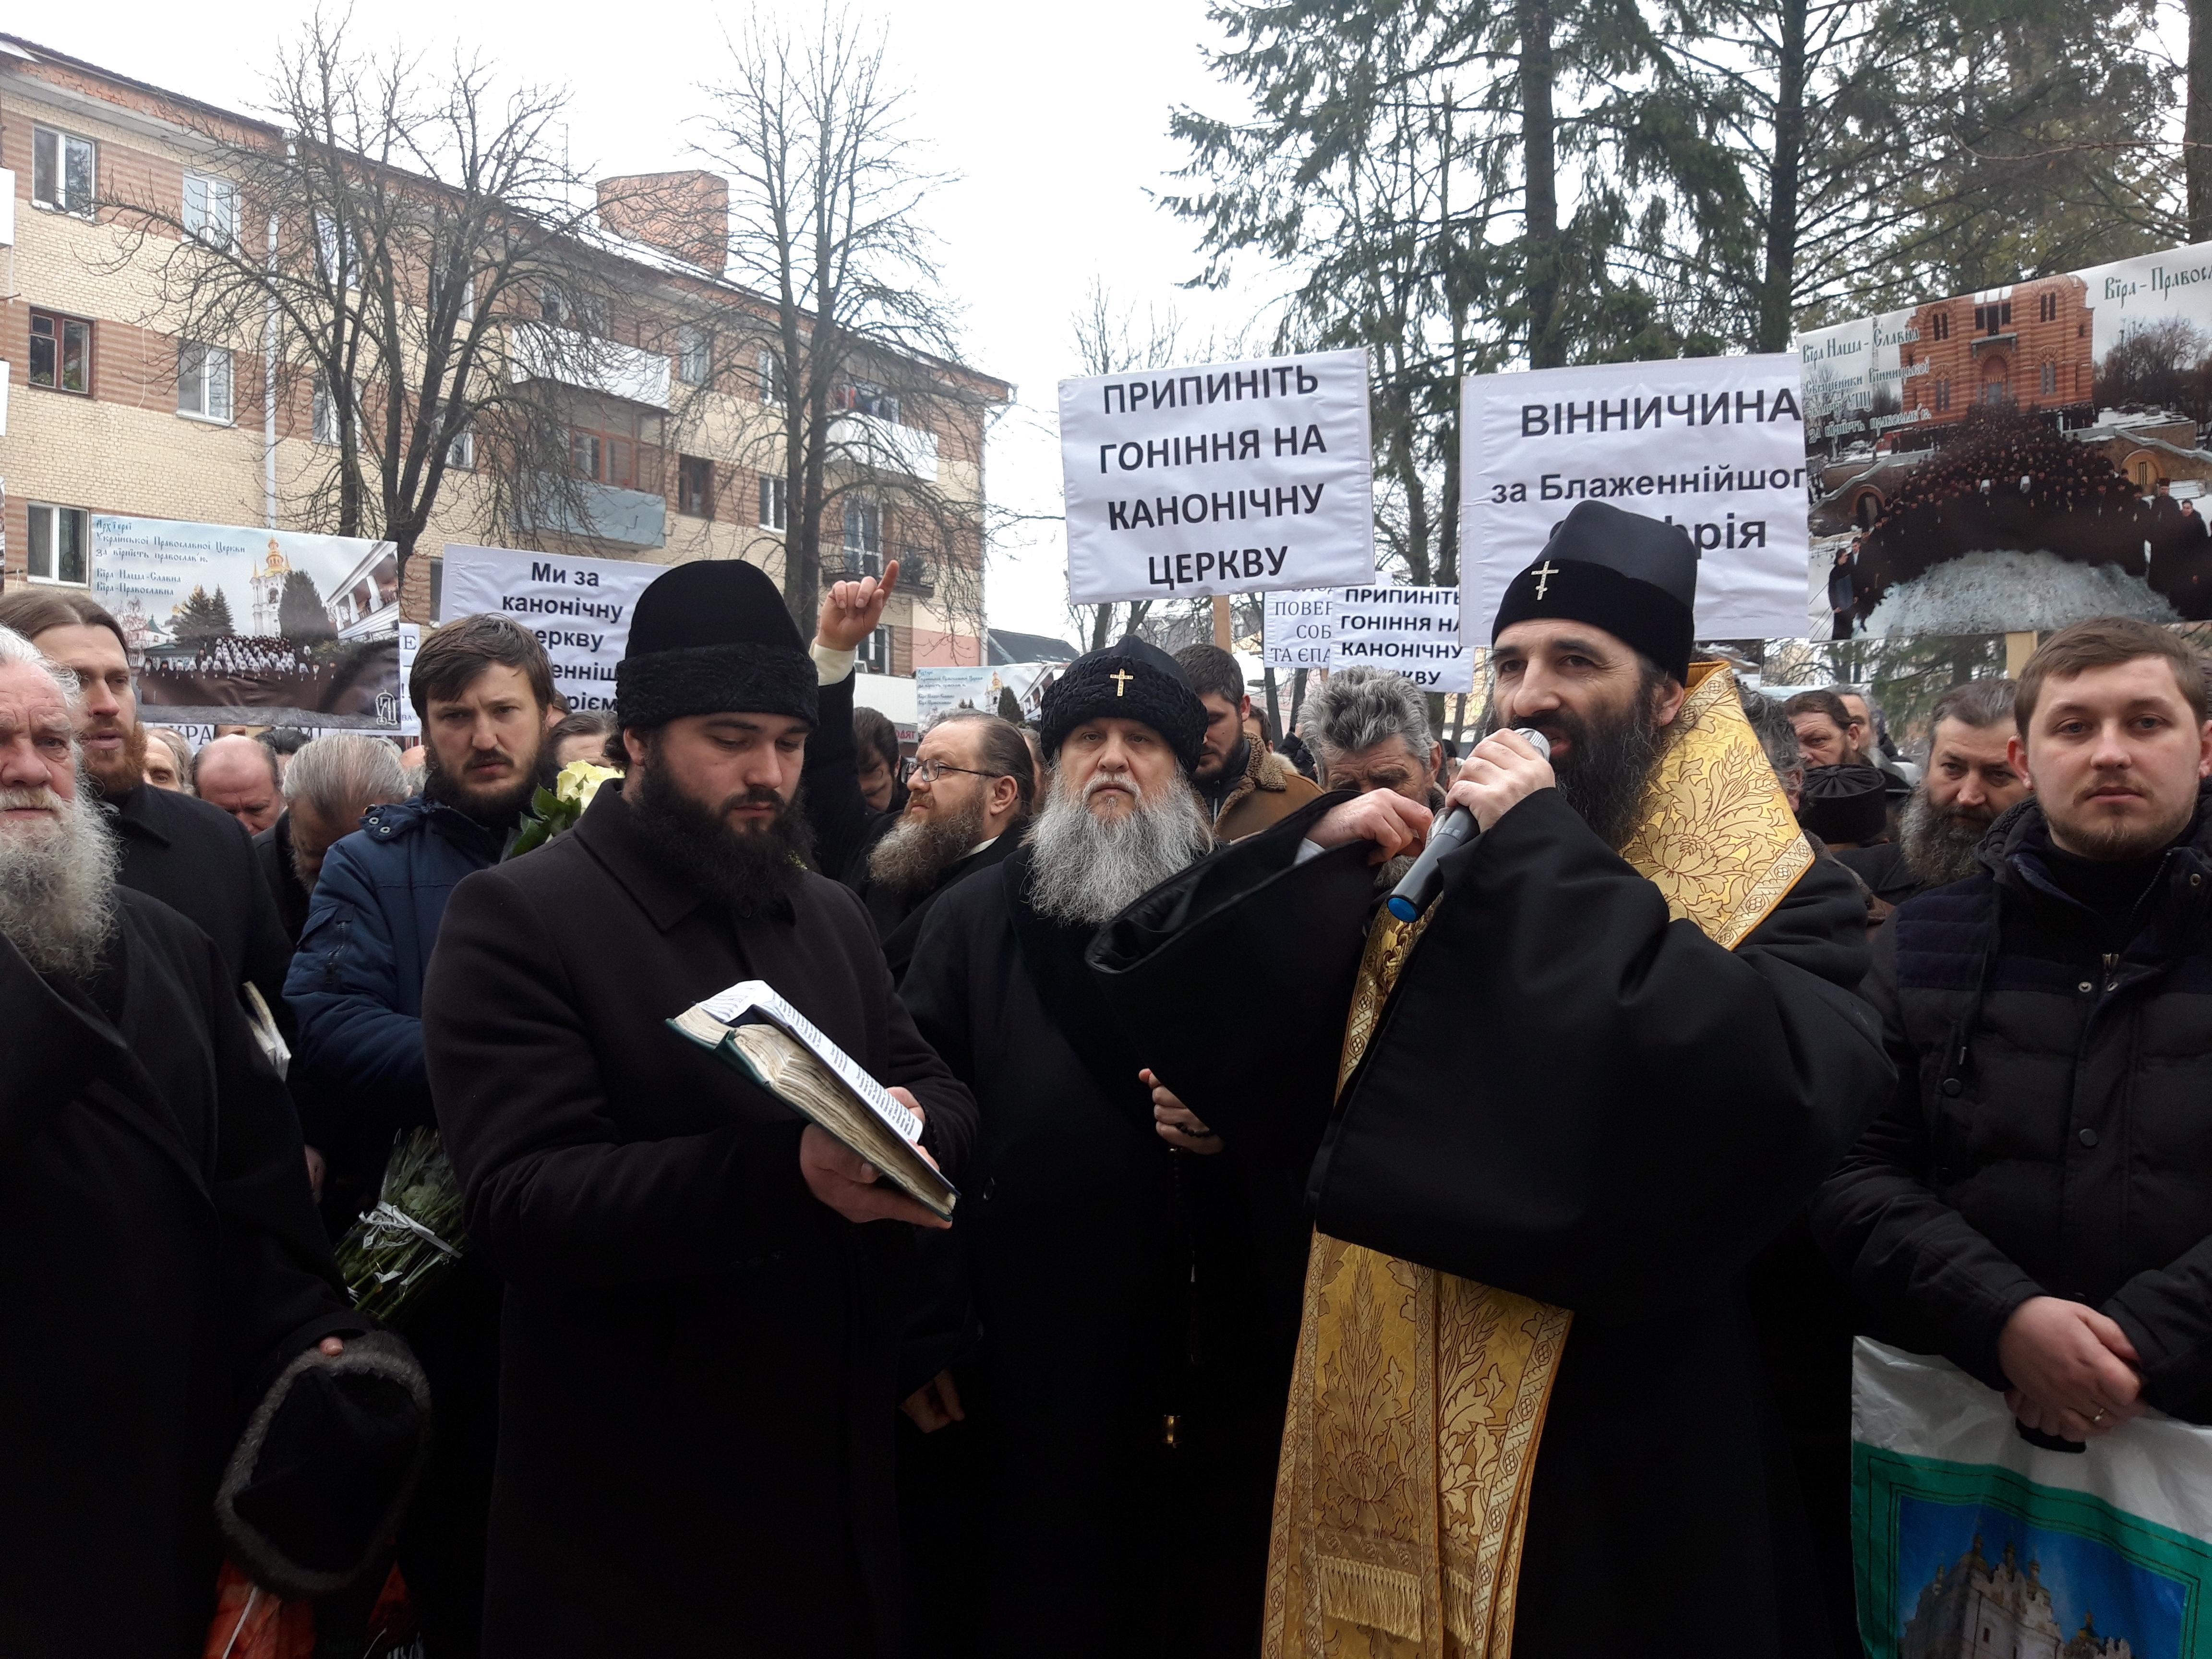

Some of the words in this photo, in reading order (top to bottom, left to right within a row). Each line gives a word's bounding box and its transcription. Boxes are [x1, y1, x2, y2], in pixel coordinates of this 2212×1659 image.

[1103, 365, 1318, 414] ПРИПИНІТЬ
[1521, 388, 1802, 438] ВІННИЧИНА
[1100, 429, 1260, 474] ГОНІННЯ
[1274, 424, 1327, 457] НА
[1491, 483, 1527, 503] за
[1540, 464, 1806, 501] Блаженнійшог
[1107, 483, 1324, 530] КАНОНІЧНУ
[531, 562, 566, 584] Ми
[574, 571, 600, 587] за
[1148, 545, 1288, 590] ЦЕРКВУ
[502, 596, 624, 623] канонічну
[1297, 625, 1331, 639] СОБ
[1341, 615, 1431, 632] ГОНІННЯ
[530, 629, 604, 652] еркву
[1341, 642, 1463, 659] КАНОНІЧНУ
[1270, 648, 1293, 662] ТА
[1298, 648, 1330, 662] ЄПА
[553, 662, 618, 681] енніш
[567, 692, 617, 711] рієм
